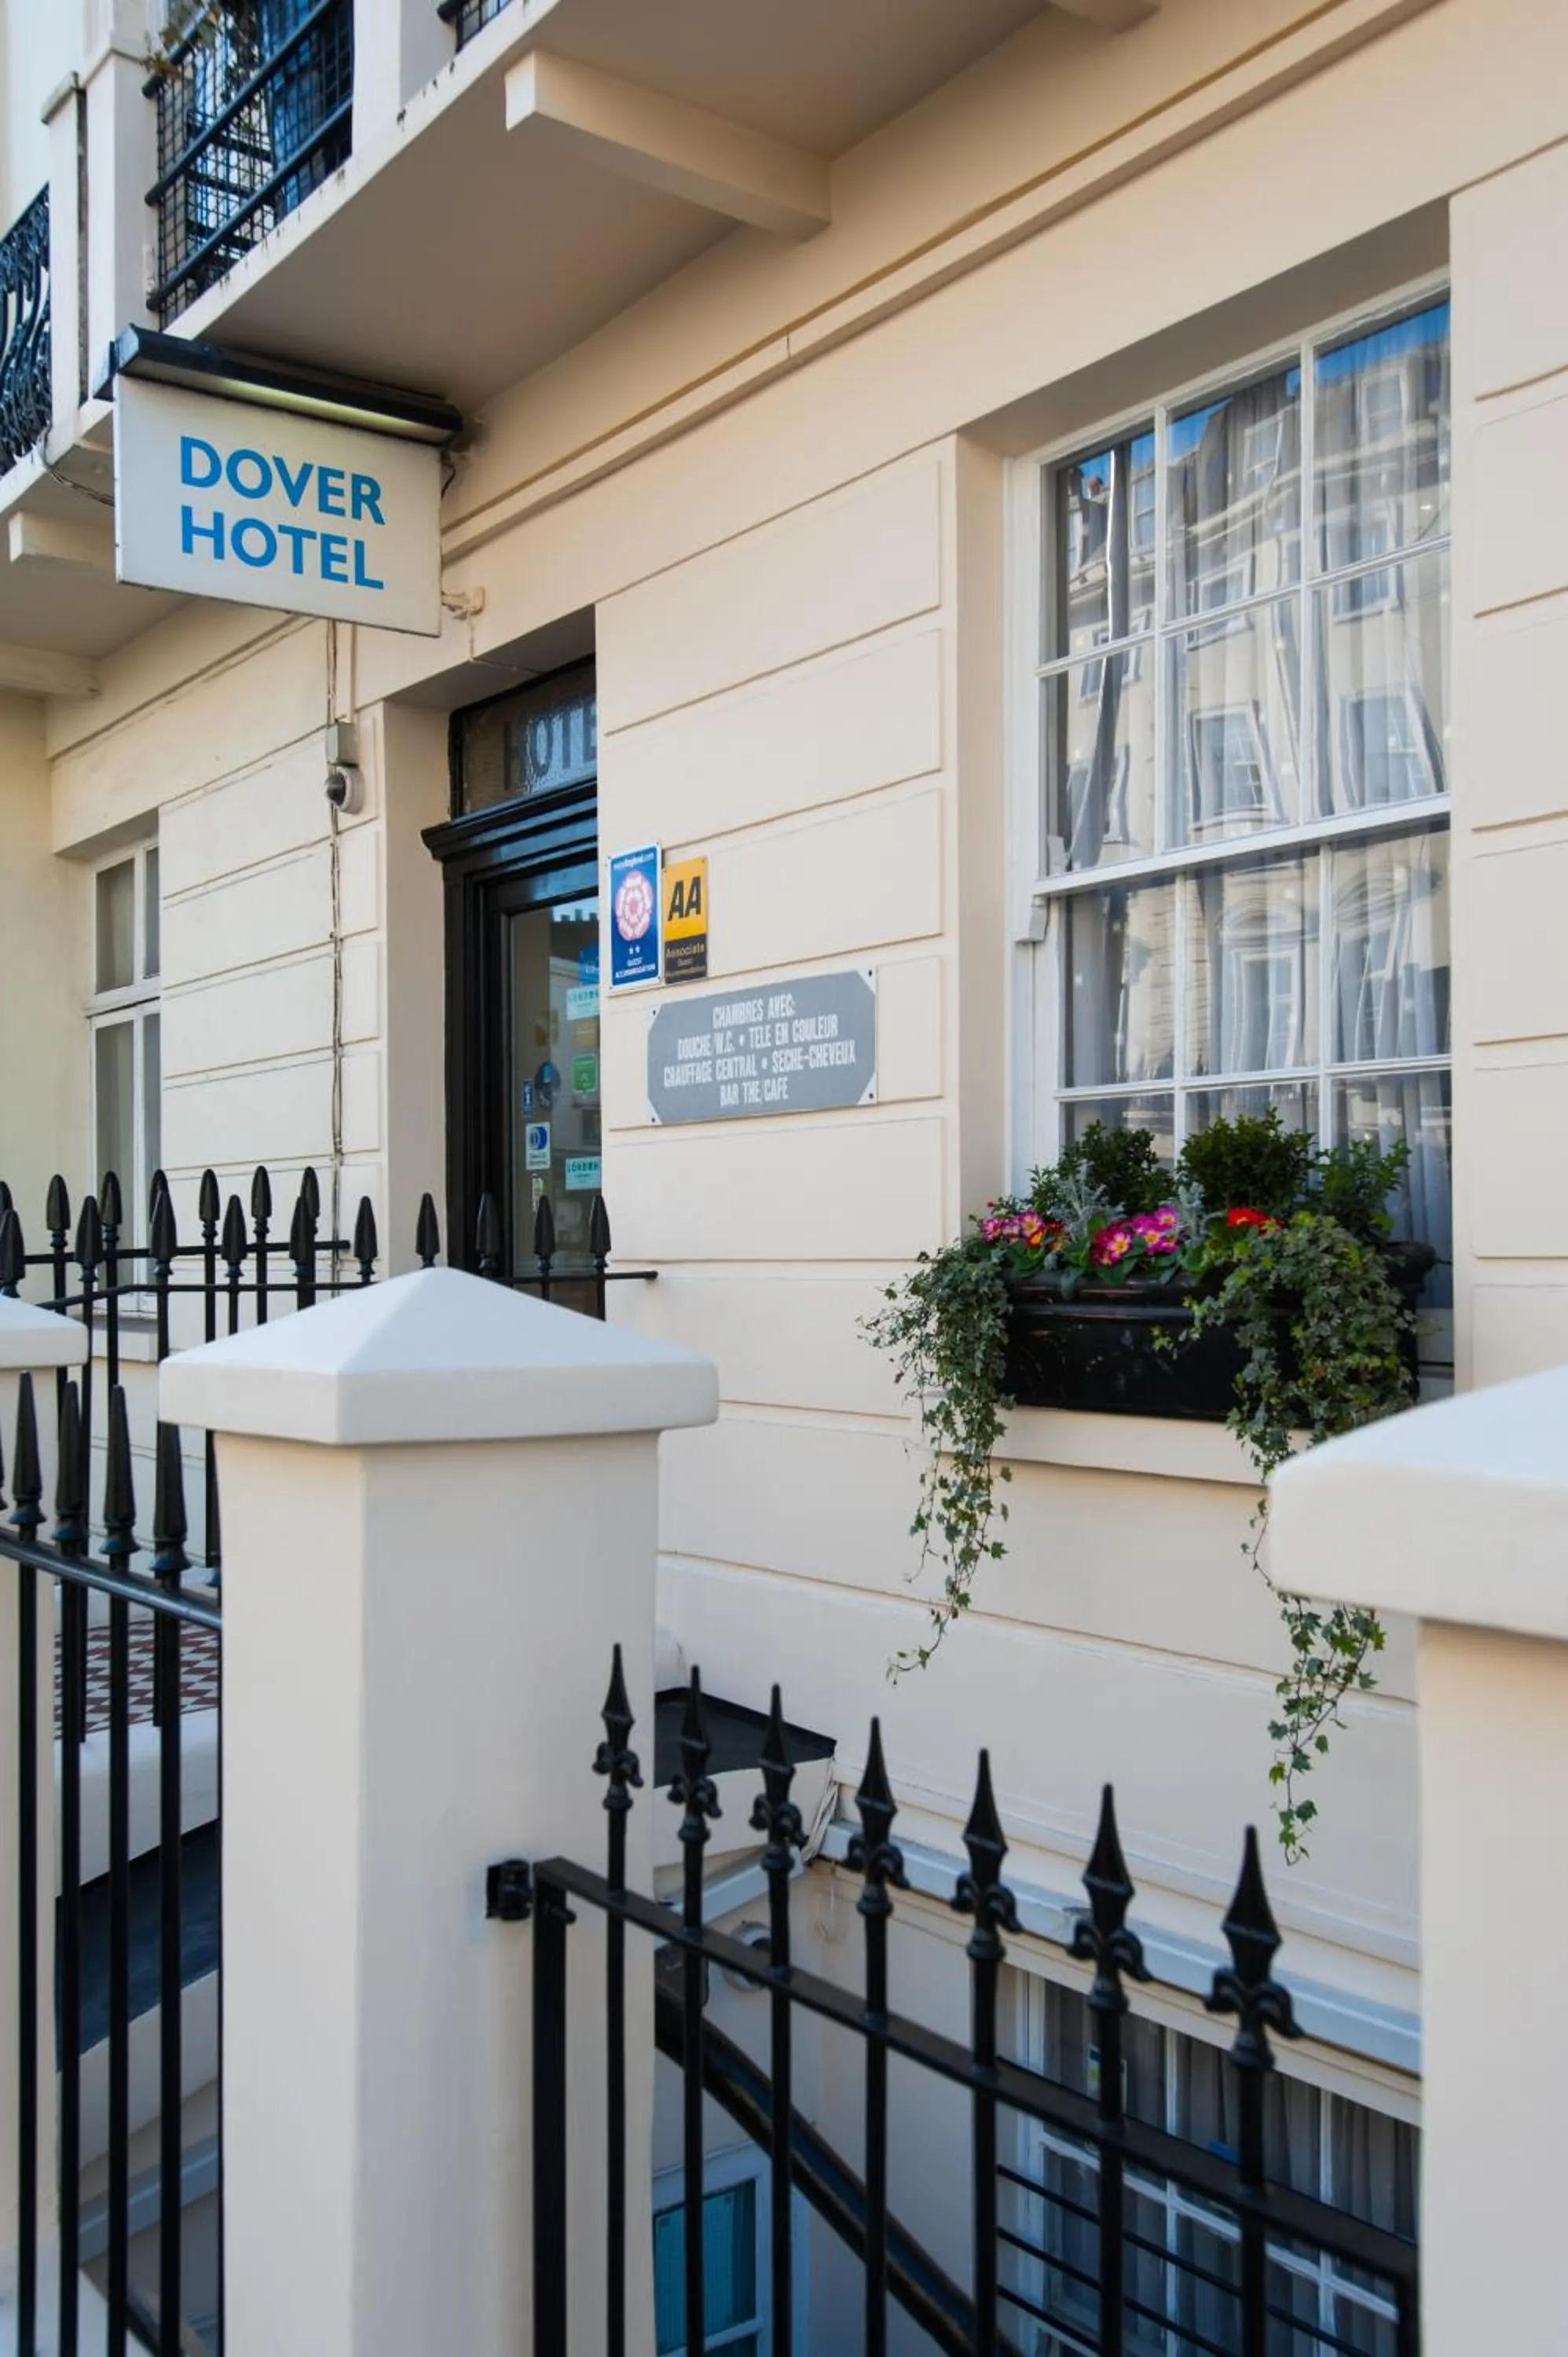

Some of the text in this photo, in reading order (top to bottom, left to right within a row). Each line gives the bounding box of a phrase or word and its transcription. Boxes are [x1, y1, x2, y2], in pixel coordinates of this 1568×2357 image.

[180, 435, 385, 525] DOVER
[181, 504, 384, 590] HOTEL
[668, 875, 702, 922] AA
[677, 1034, 712, 1061] DOUCHE
[748, 1025, 771, 1050] TELE
[775, 1021, 789, 1046] EN
[792, 1014, 838, 1043] COULEUR
[713, 999, 764, 1029] CHAMBRES
[663, 1060, 713, 1088] CHAUFFAGE
[716, 1054, 758, 1081] CENTRAL
[720, 1083, 739, 1107] BAR
